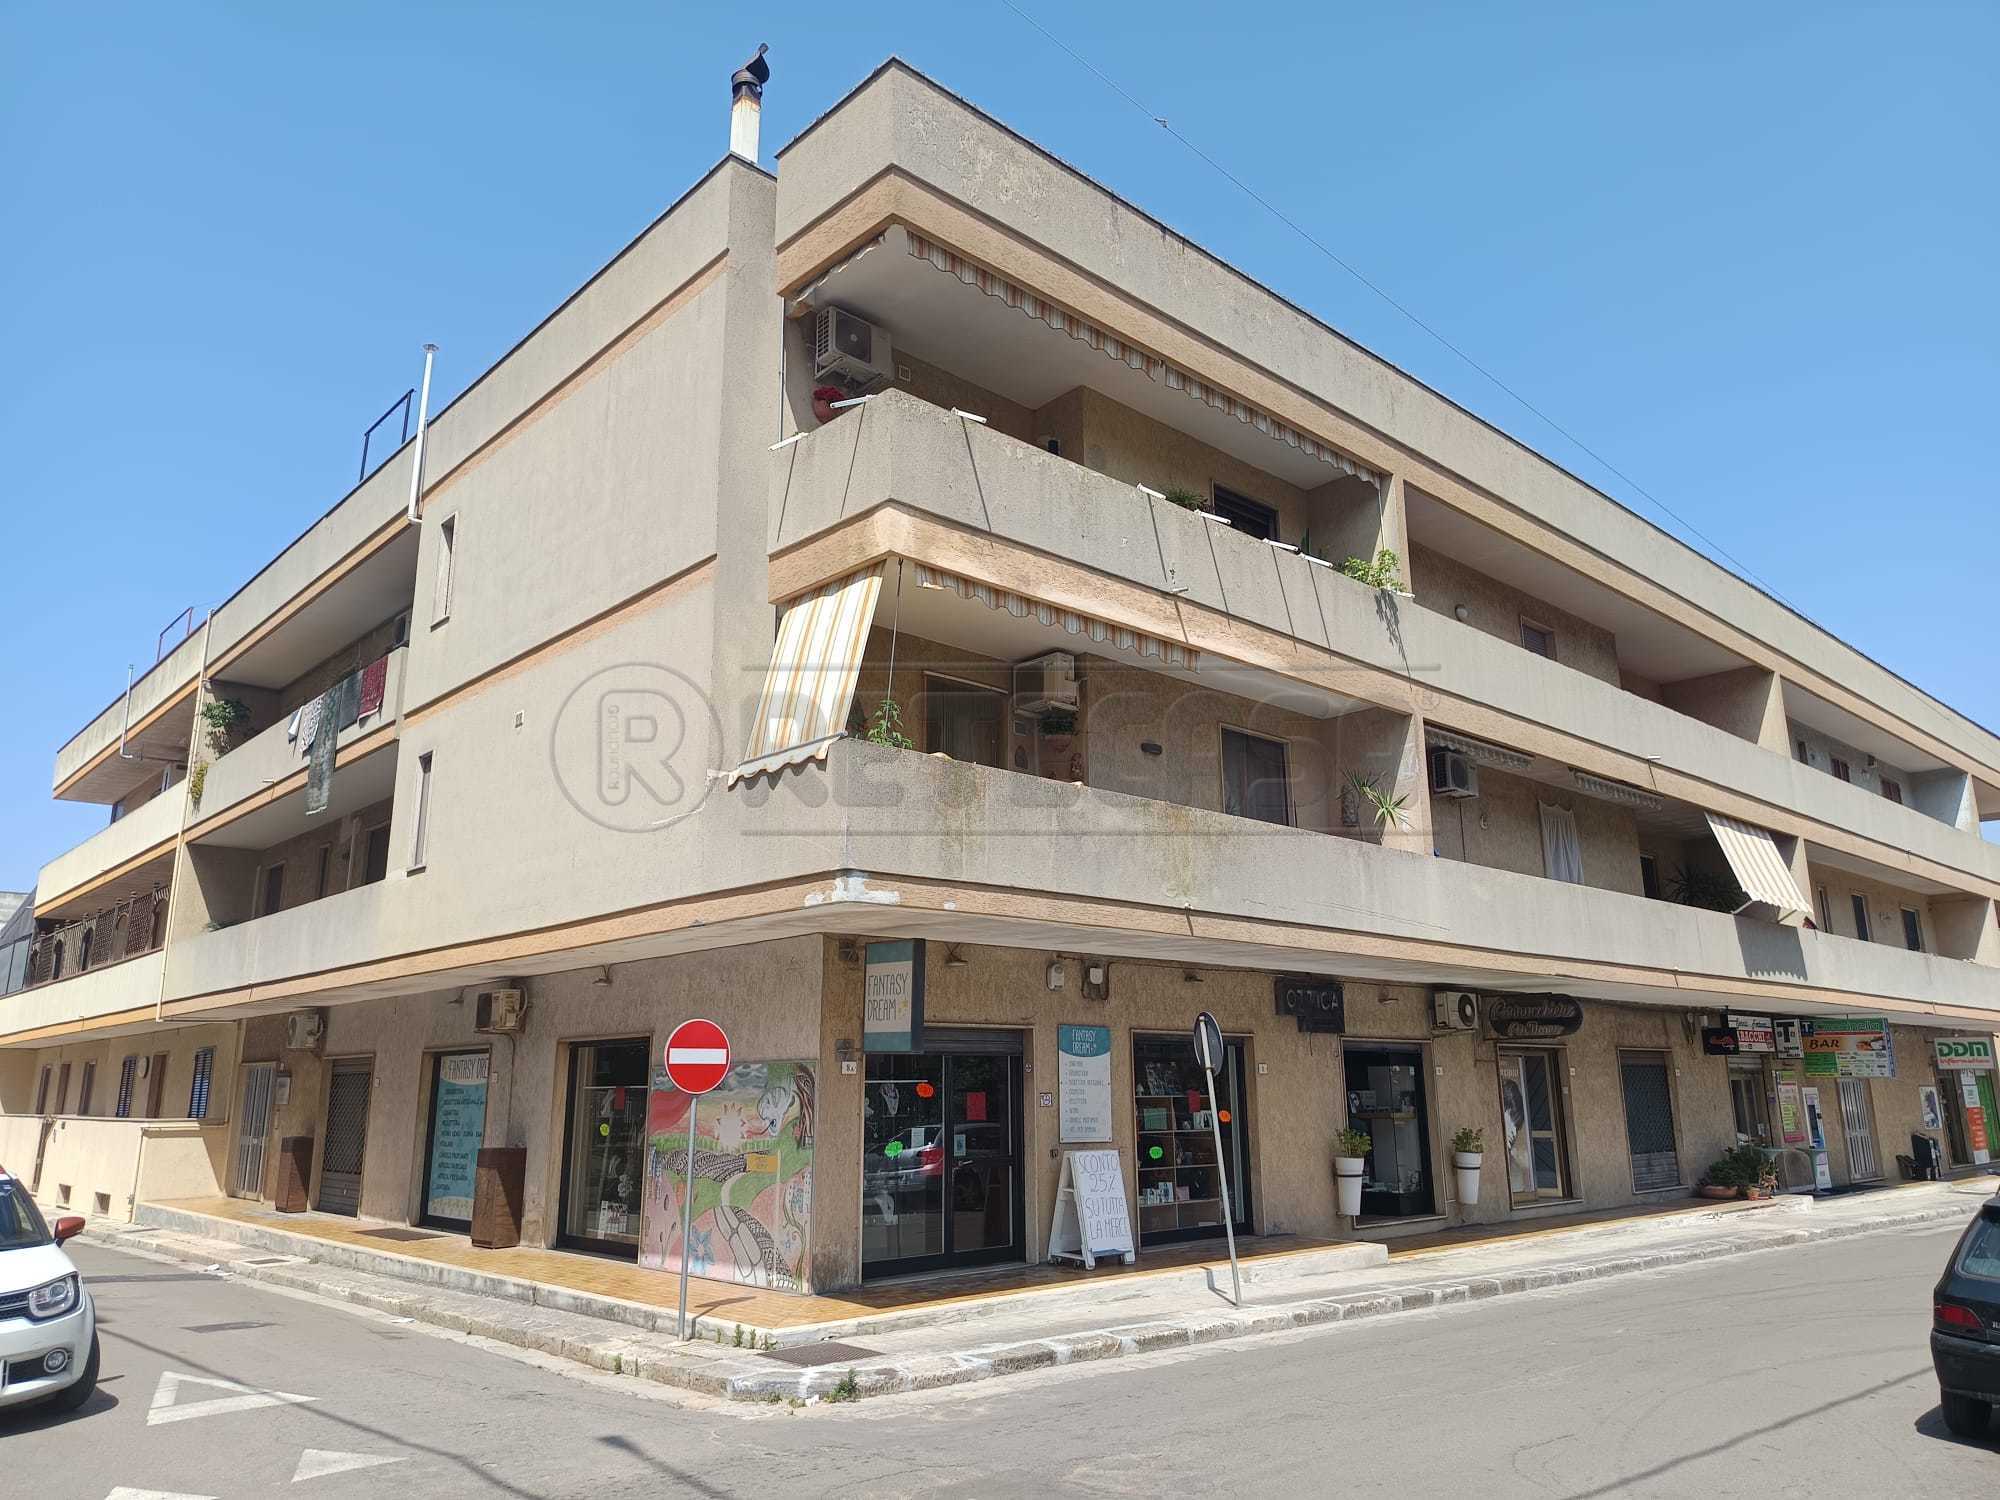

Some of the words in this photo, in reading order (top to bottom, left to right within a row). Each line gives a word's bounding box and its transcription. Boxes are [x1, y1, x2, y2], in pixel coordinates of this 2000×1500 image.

[868, 972, 908, 997] FANTASY
[867, 998, 896, 1021] DREAM
[1073, 1029, 1096, 1041] FANTASY
[1809, 1038, 1840, 1050] BAR
[1073, 1042, 1091, 1054] DREAM
[448, 1059, 477, 1081] FANTASY
[1080, 1153, 1119, 1174] SCONTO
[1089, 1173, 1116, 1193] 25%
[1085, 1198, 1100, 1218] SU
[1101, 1196, 1125, 1216] TUTTA
[1089, 1220, 1103, 1240] LA
